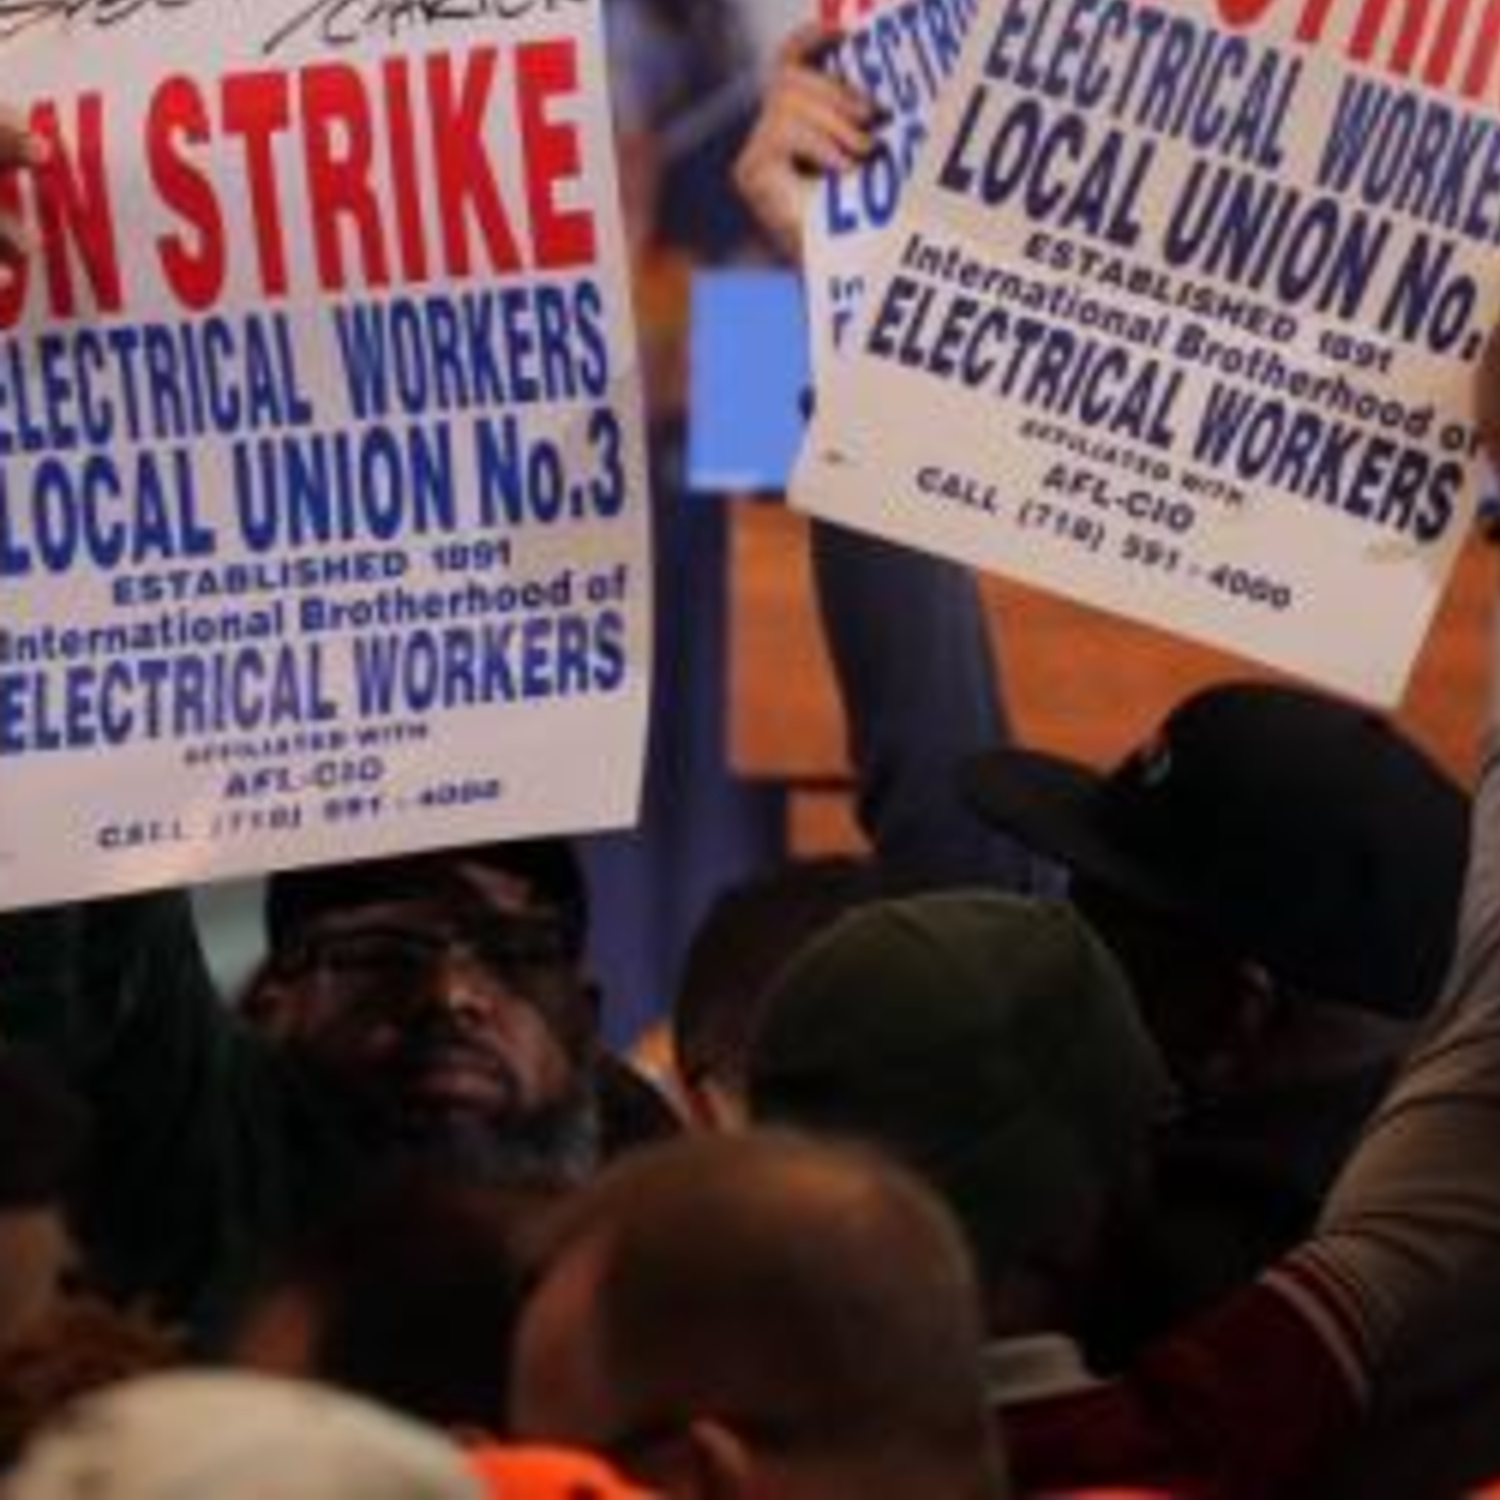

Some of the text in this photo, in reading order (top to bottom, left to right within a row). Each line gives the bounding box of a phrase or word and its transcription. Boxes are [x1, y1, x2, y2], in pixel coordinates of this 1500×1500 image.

[145, 38, 597, 312] STRIKE
[937, 84, 1156, 251] LOCAL
[1161, 161, 1392, 322] UNION
[335, 280, 608, 420] WORKERS
[902, 233, 1164, 350] International
[1174, 318, 1434, 438] Brotherhood
[1024, 232, 1394, 374] ESTABLISHED 1891
[867, 273, 1188, 450] ELECTRICAL
[1192, 380, 1465, 544] WORKERS
[0, 407, 626, 578] LOCAL UNION No.3
[916, 464, 1001, 516] CALL
[1017, 498, 1107, 551] (718)
[1120, 532, 1180, 574] 591
[1207, 566, 1293, 610] 4000
[1042, 461, 1196, 533] AFL-CIO
[111, 550, 409, 607] ESTABLISHED
[300, 571, 573, 631] Brotherhood
[587, 561, 628, 603] of
[0, 611, 626, 756] ELECTRICAL WORKERS
